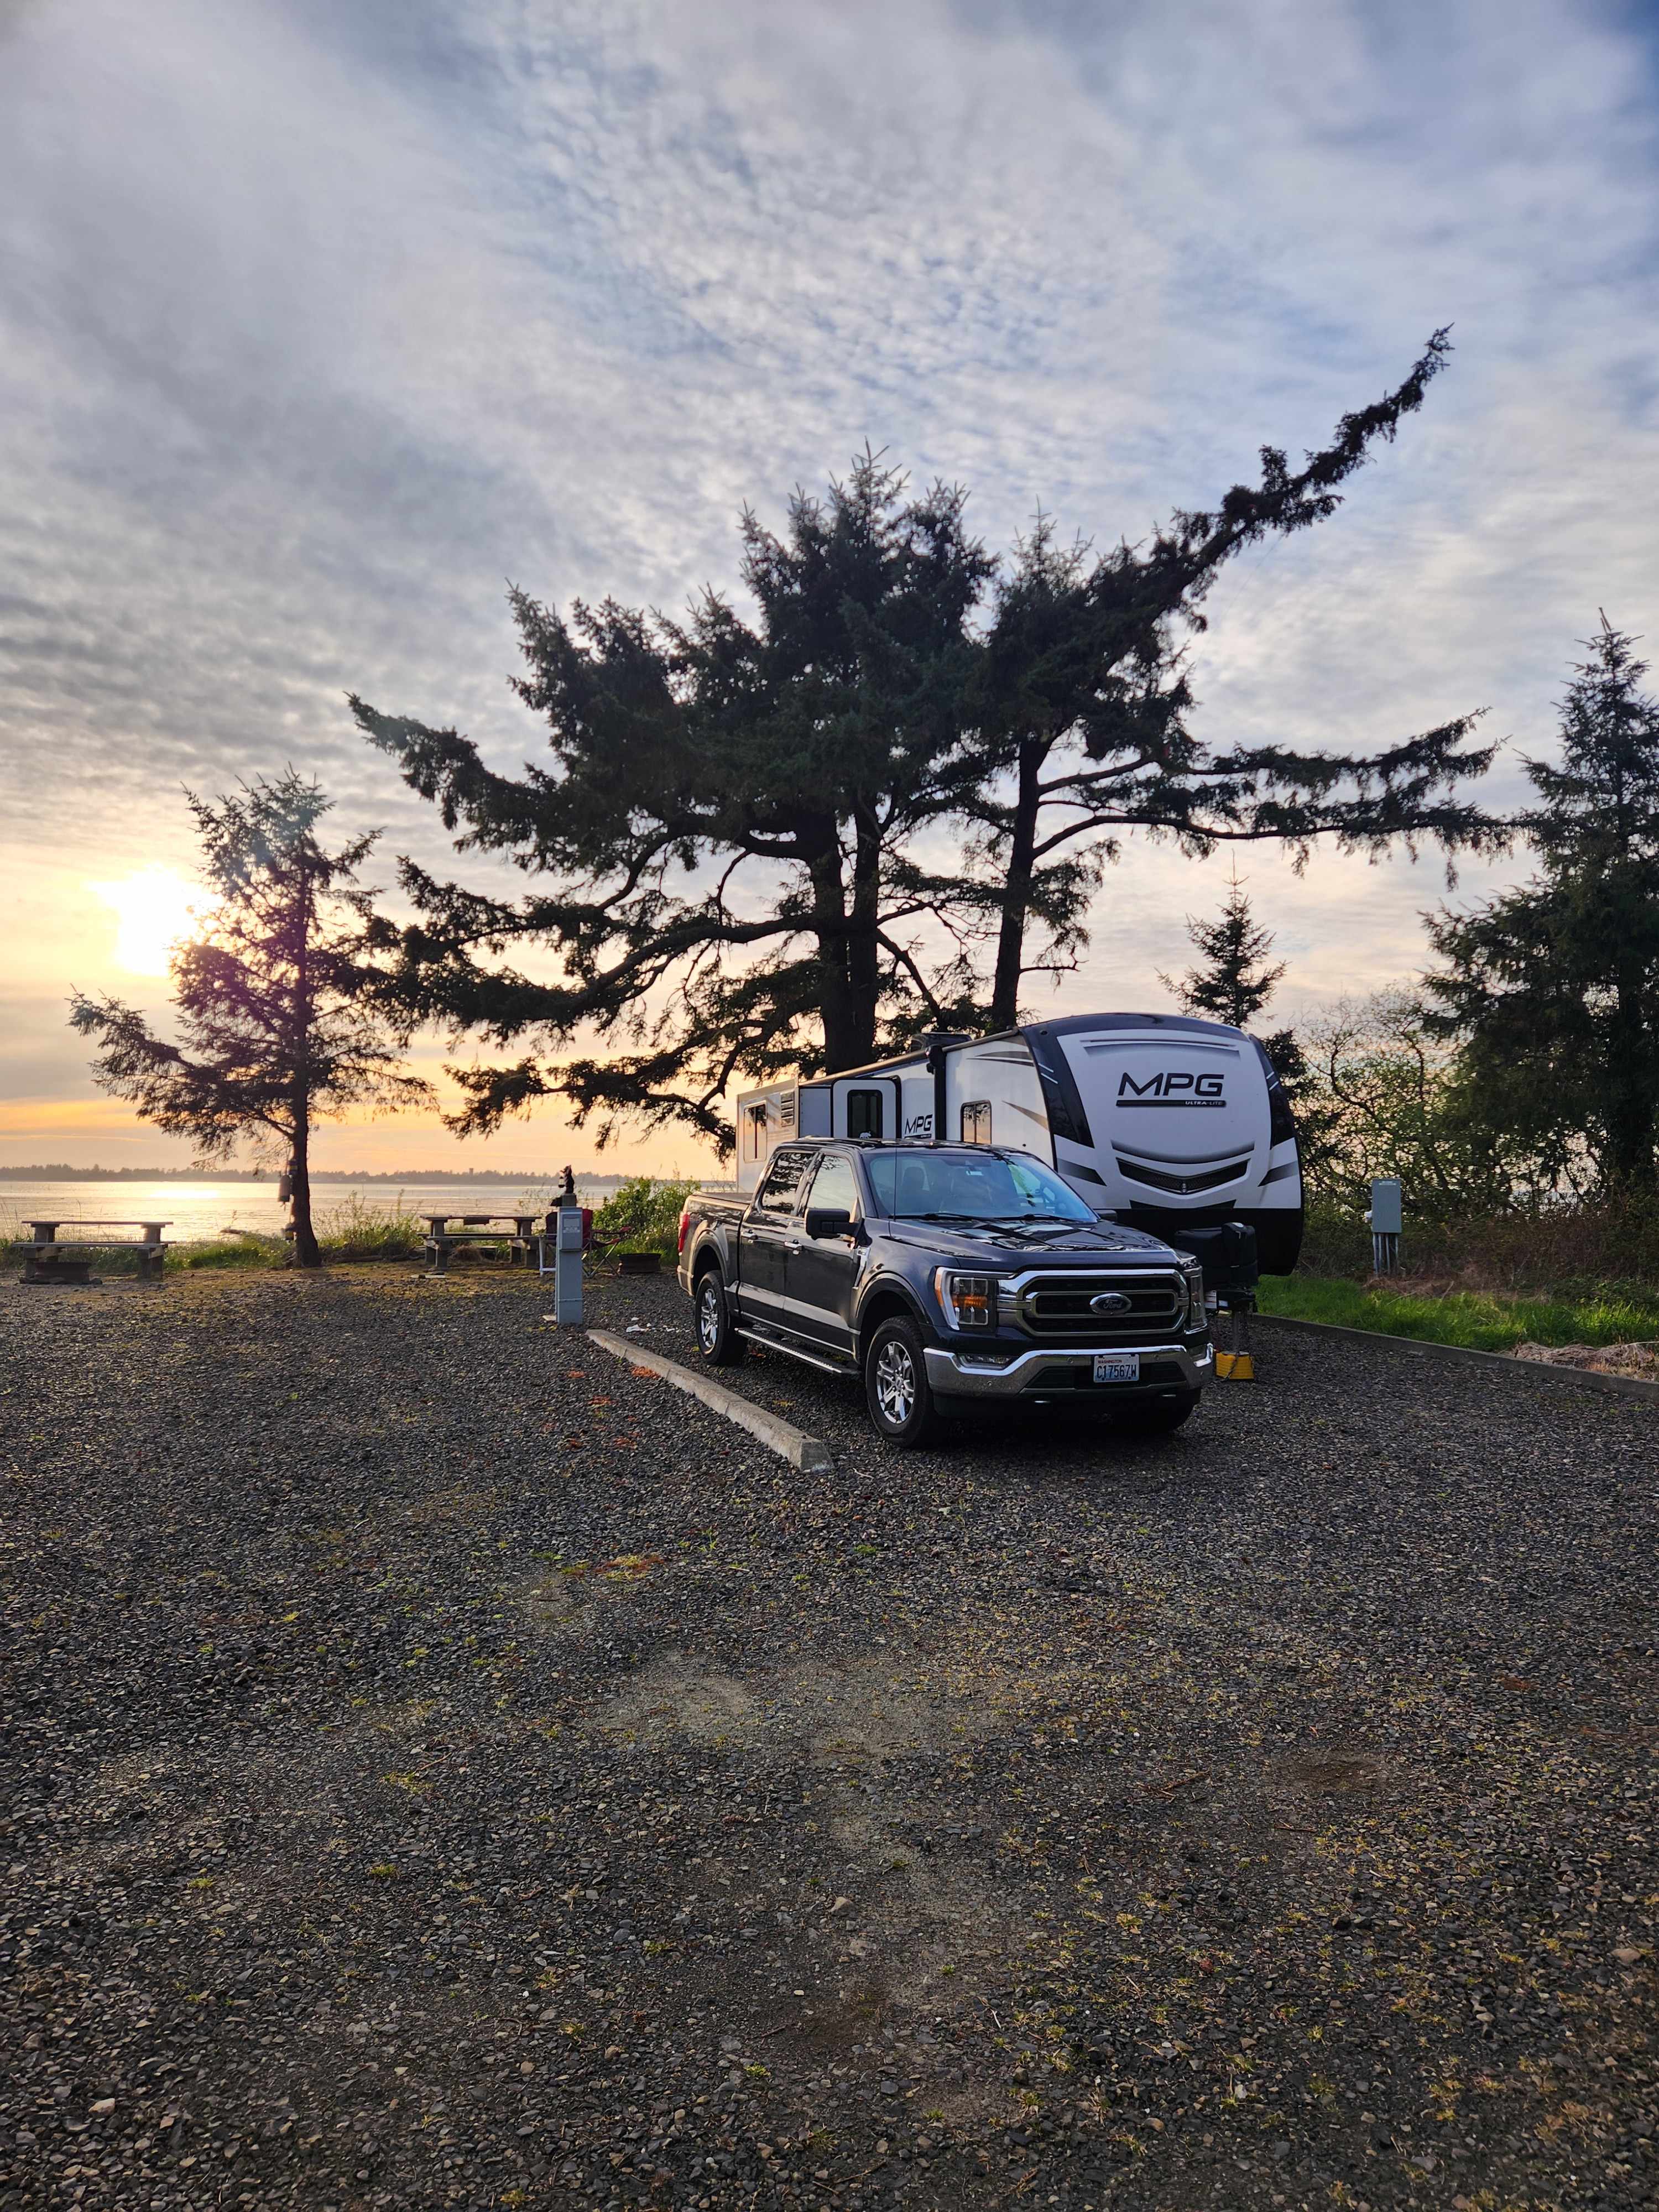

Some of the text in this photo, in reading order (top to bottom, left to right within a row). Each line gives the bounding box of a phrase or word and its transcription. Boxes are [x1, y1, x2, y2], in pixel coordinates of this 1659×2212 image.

[1118, 1072, 1224, 1097] MPG
[904, 1114, 933, 1134] MPG
[1103, 1299, 1122, 1309] Ford
[1097, 1364, 1136, 1378] C17567W
